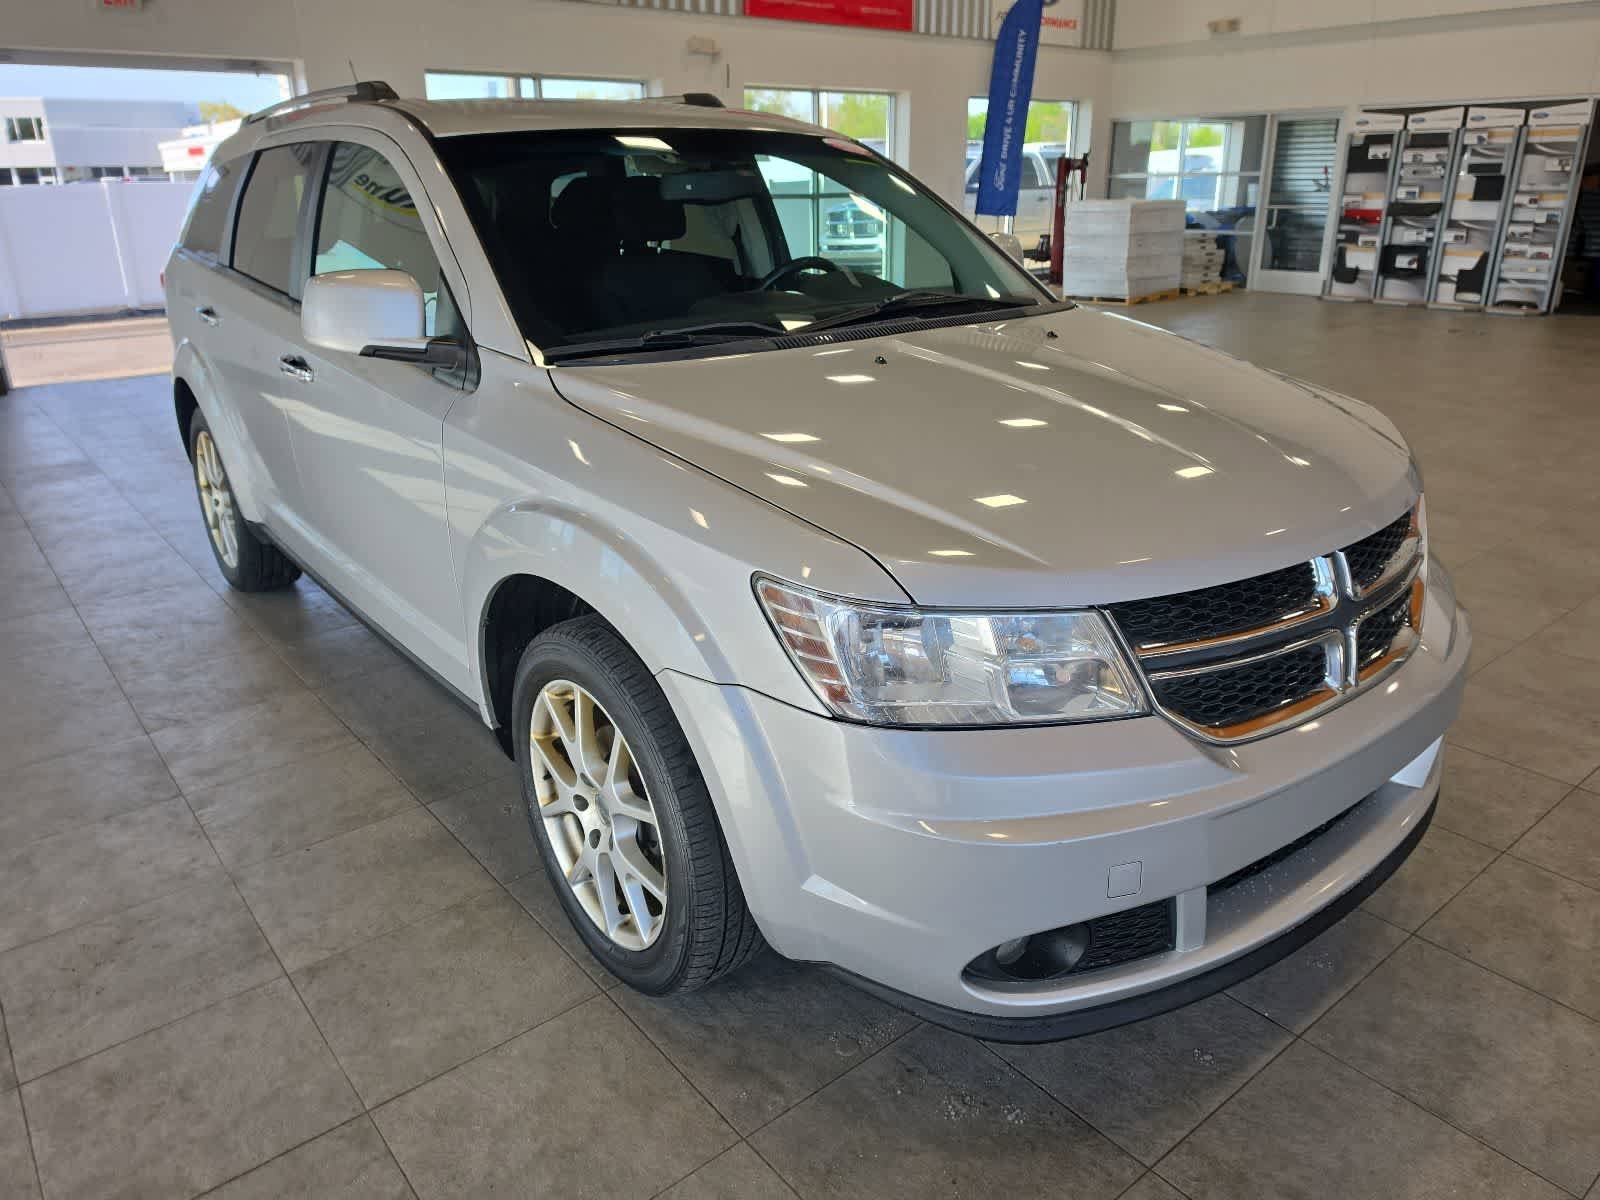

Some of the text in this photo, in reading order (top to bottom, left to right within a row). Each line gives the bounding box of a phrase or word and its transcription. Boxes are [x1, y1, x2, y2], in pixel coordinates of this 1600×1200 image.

[993, 161, 1007, 192] Ford
[1001, 127, 1013, 159] DRIVE
[1010, 30, 1027, 98] COMMUNITY
